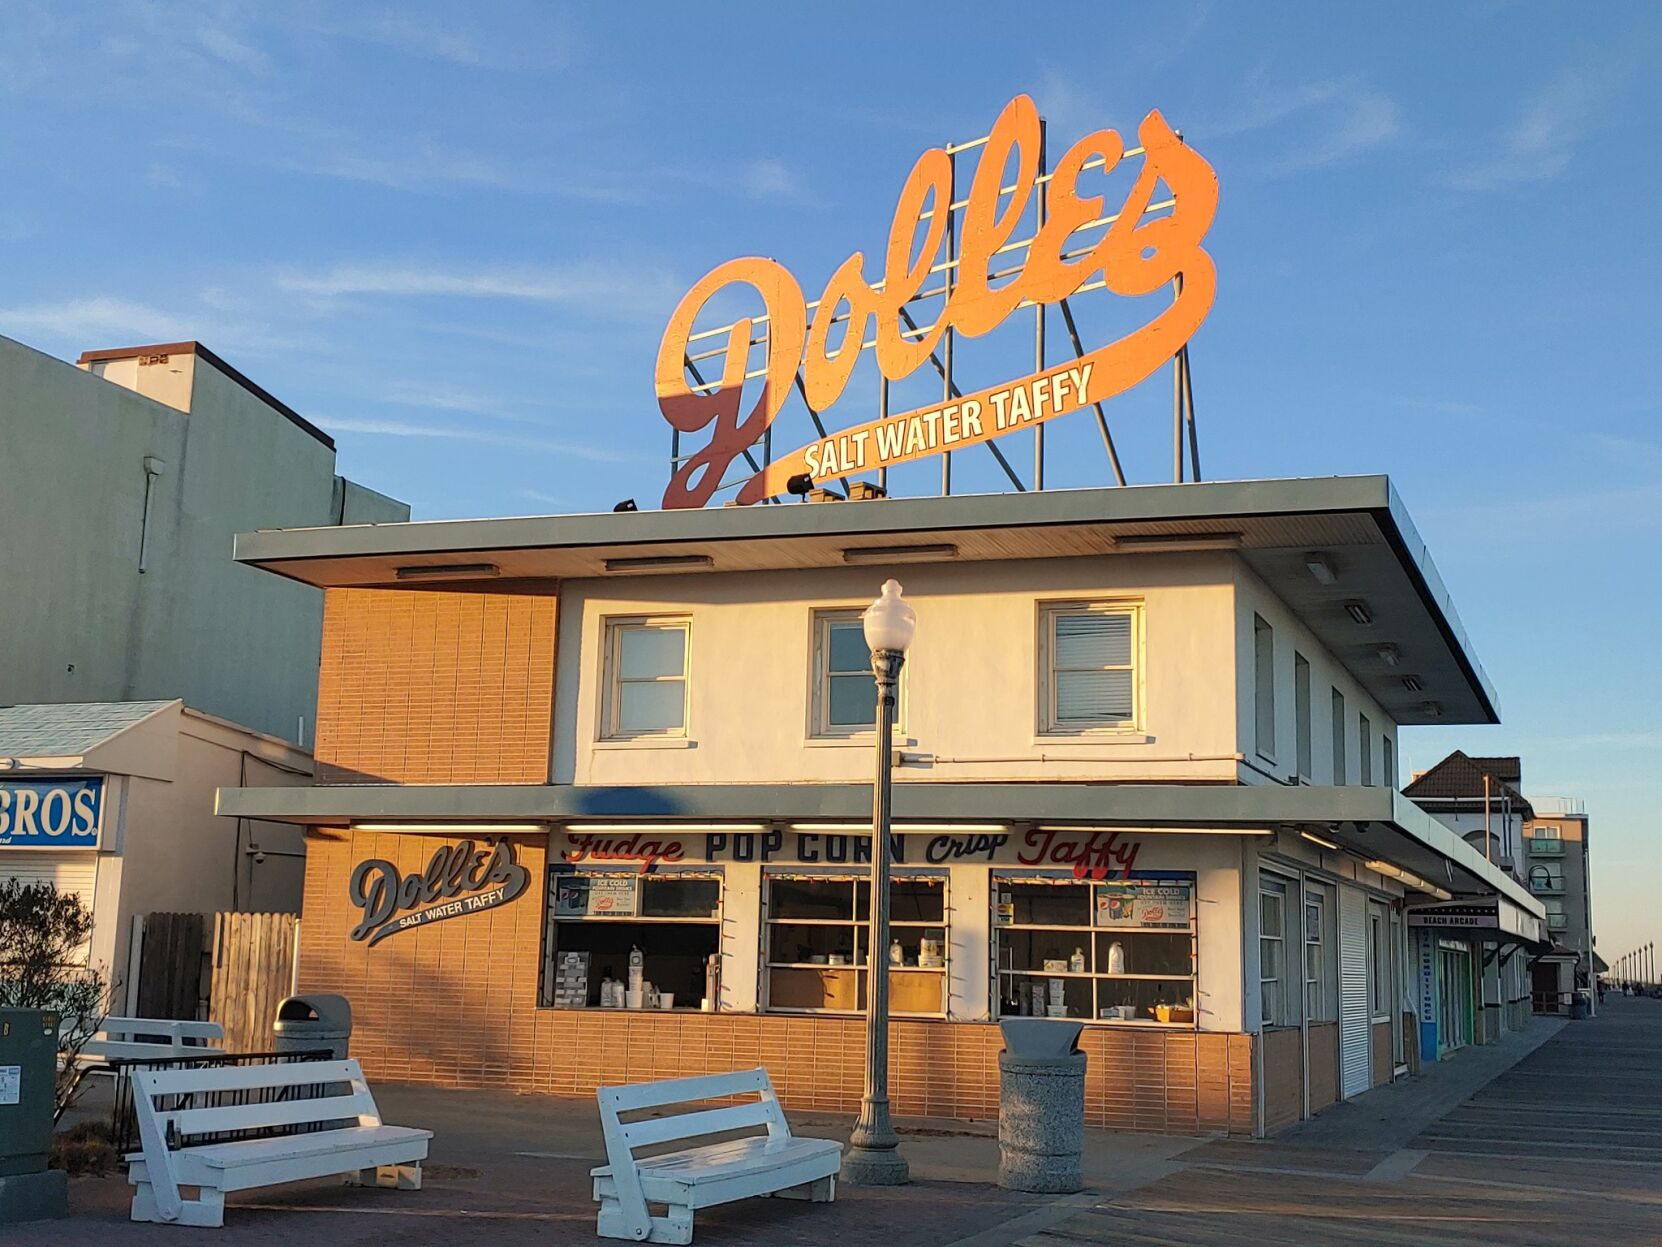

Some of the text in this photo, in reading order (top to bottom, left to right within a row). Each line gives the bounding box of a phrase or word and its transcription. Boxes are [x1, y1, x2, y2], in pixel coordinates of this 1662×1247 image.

[803, 362, 1094, 479] SALT WATER TAFFY
[561, 829, 1141, 880] Fudge POP CORN Crisp Taffy
[399, 888, 505, 928] SALT WATER TAFFY
[1423, 916, 1479, 925] BEACH ARCADE
